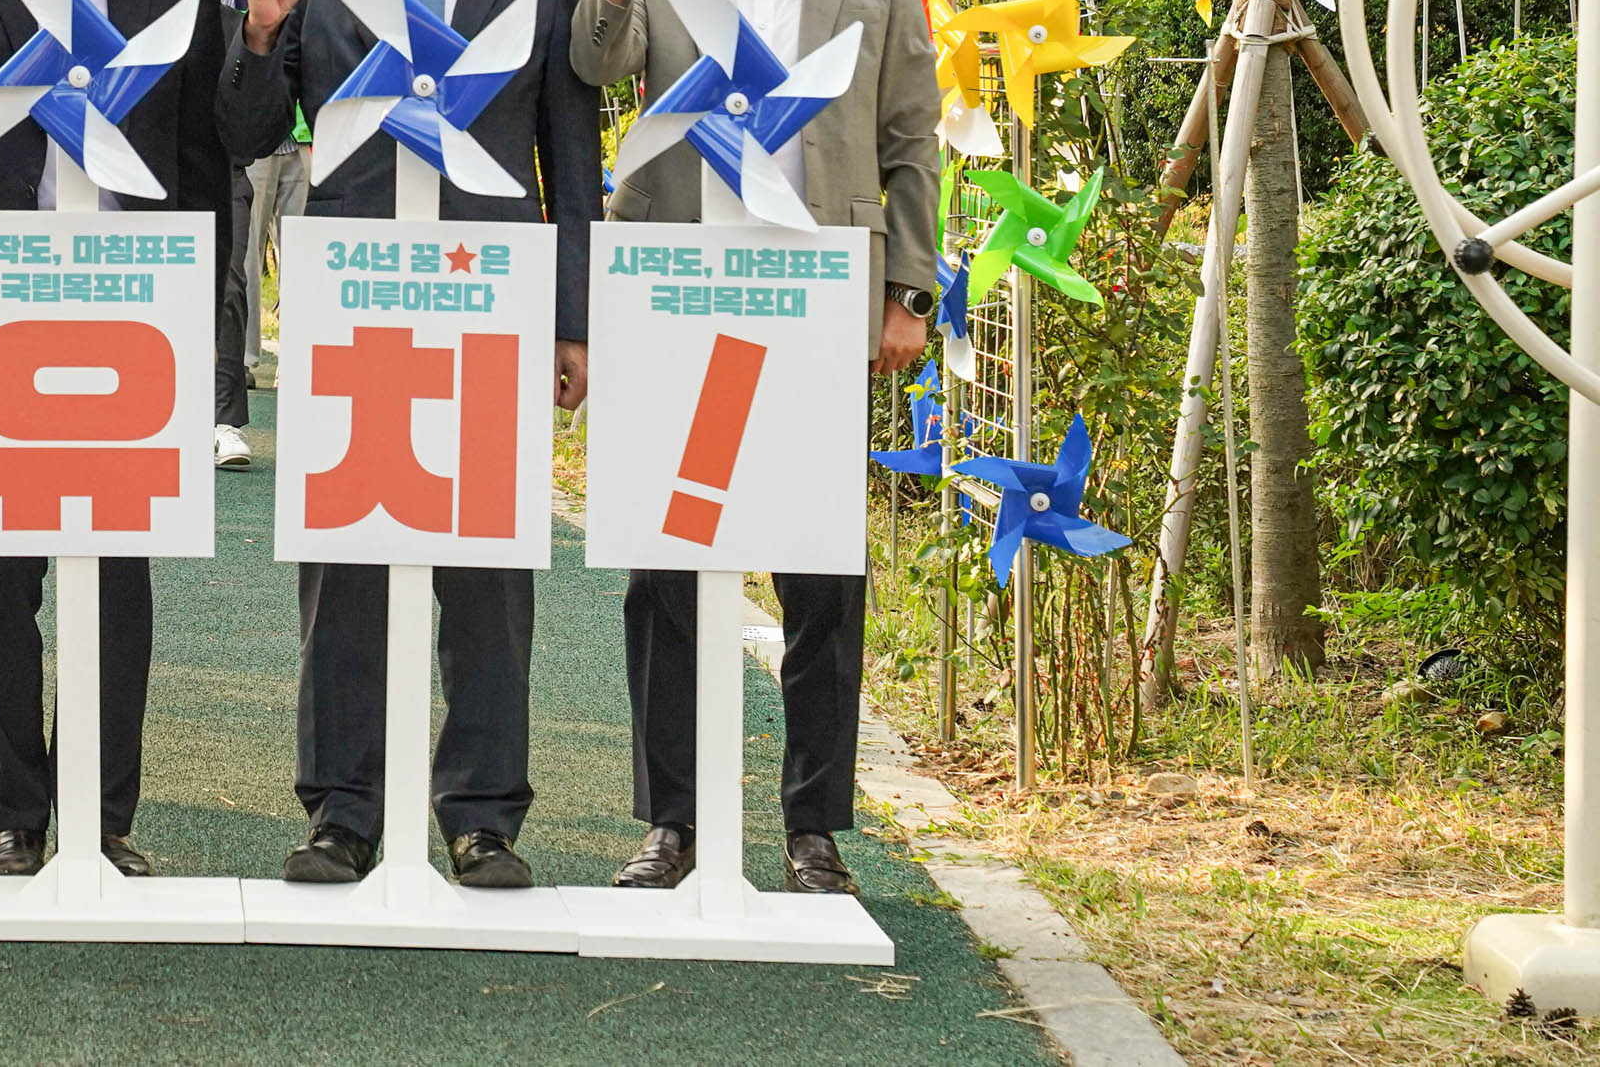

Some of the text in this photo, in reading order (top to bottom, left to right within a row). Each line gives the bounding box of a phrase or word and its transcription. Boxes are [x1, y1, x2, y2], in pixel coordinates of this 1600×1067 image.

[73, 234, 196, 266] 마침표도
[326, 241, 400, 273] 34년
[608, 245, 850, 280] 시작도, 마침표도
[0, 272, 154, 303] 국립목포대
[340, 279, 495, 313] 이루어진다
[650, 285, 807, 318] 국립목포대
[304, 326, 520, 539] 치
[662, 333, 768, 547] !
